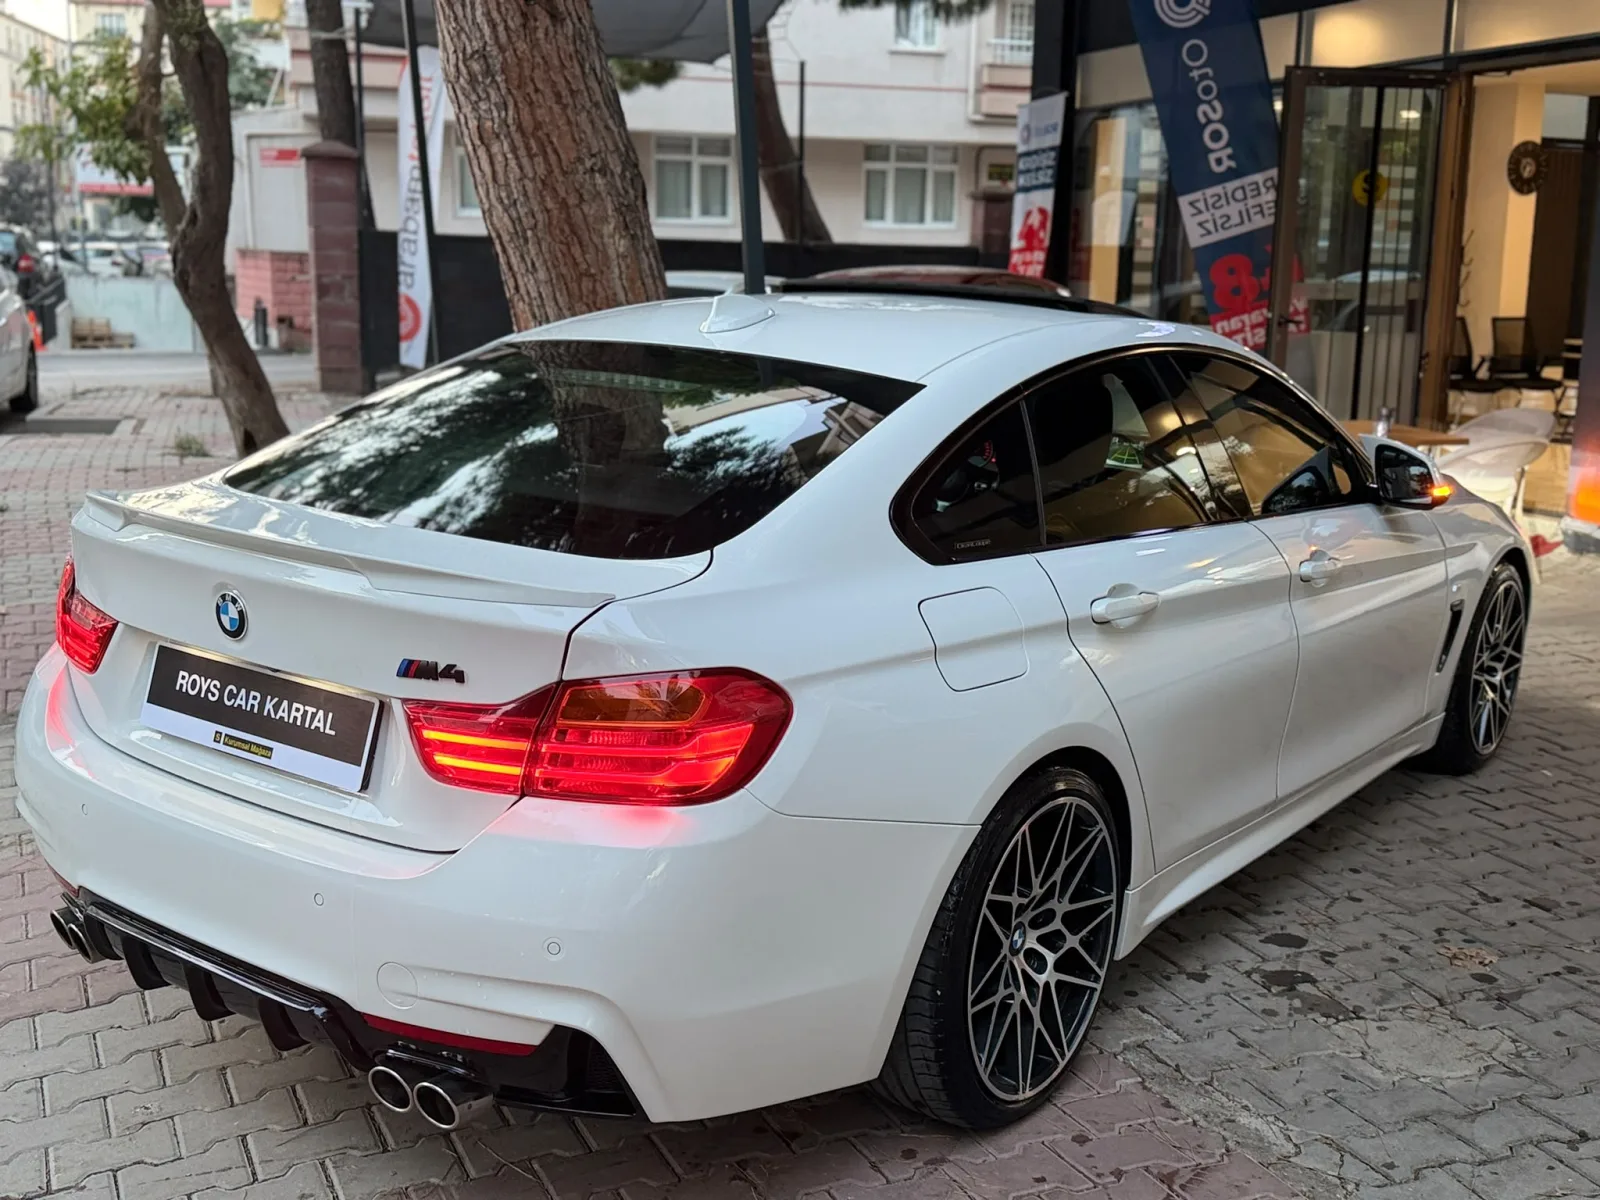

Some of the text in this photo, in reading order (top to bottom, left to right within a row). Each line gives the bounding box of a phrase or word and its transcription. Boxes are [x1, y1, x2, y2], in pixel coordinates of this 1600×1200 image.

[413, 659, 465, 684] M4
[175, 669, 336, 736] ROYS CAR KARTAL
[224, 736, 250, 751] Kurumsal
